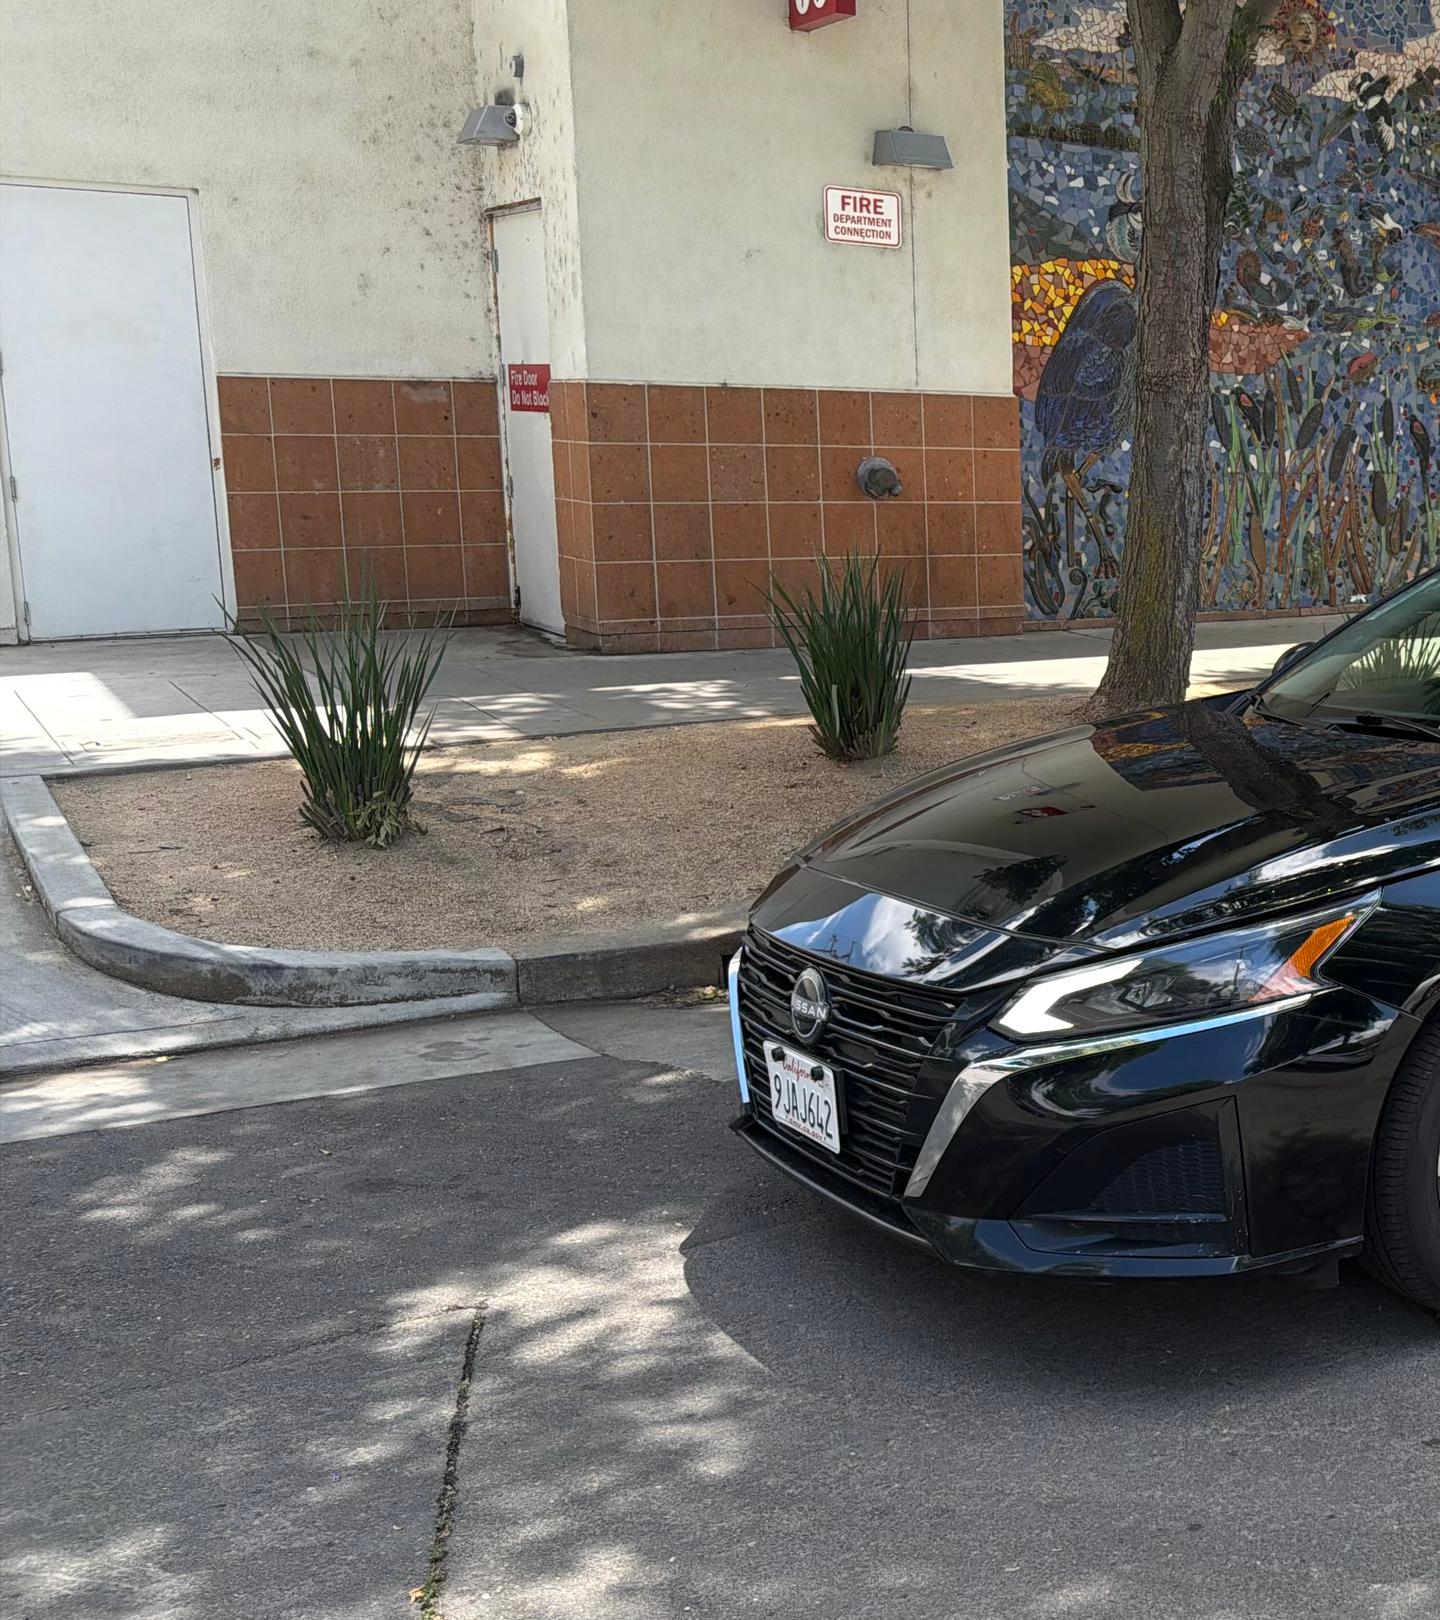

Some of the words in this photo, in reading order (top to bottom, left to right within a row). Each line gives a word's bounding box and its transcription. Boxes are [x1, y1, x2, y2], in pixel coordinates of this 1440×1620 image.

[841, 194, 884, 215] FIRE
[833, 212, 892, 228] DEPARTMENT
[834, 225, 891, 241] CONNECTION
[510, 370, 522, 386] Fire
[523, 370, 538, 386] Door
[512, 389, 520, 405] Do
[521, 389, 532, 406] Not
[796, 999, 827, 1019] SSAN
[782, 1056, 815, 1082] Californ
[774, 1074, 833, 1139] 9JAJ642
